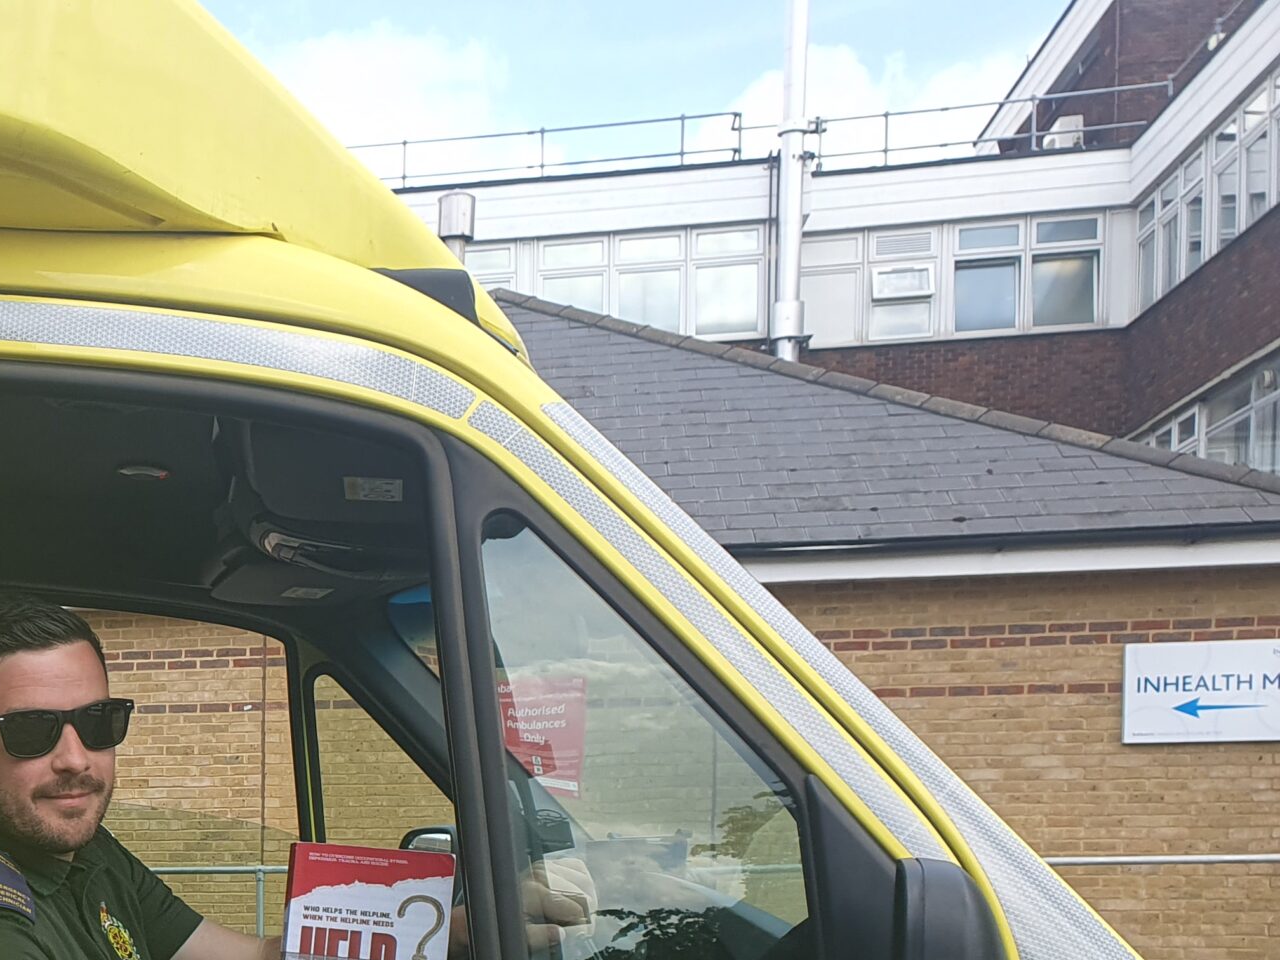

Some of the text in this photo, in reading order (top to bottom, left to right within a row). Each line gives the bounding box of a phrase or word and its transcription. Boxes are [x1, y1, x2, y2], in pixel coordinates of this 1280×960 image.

[1137, 674, 1253, 693] INHEALTH
[508, 703, 566, 717] Authorised
[507, 719, 567, 730] Ambulances
[524, 732, 546, 745] Only
[322, 906, 342, 914] HELPS
[302, 913, 323, 921] WHEN
[340, 916, 370, 926] HELPLINE
